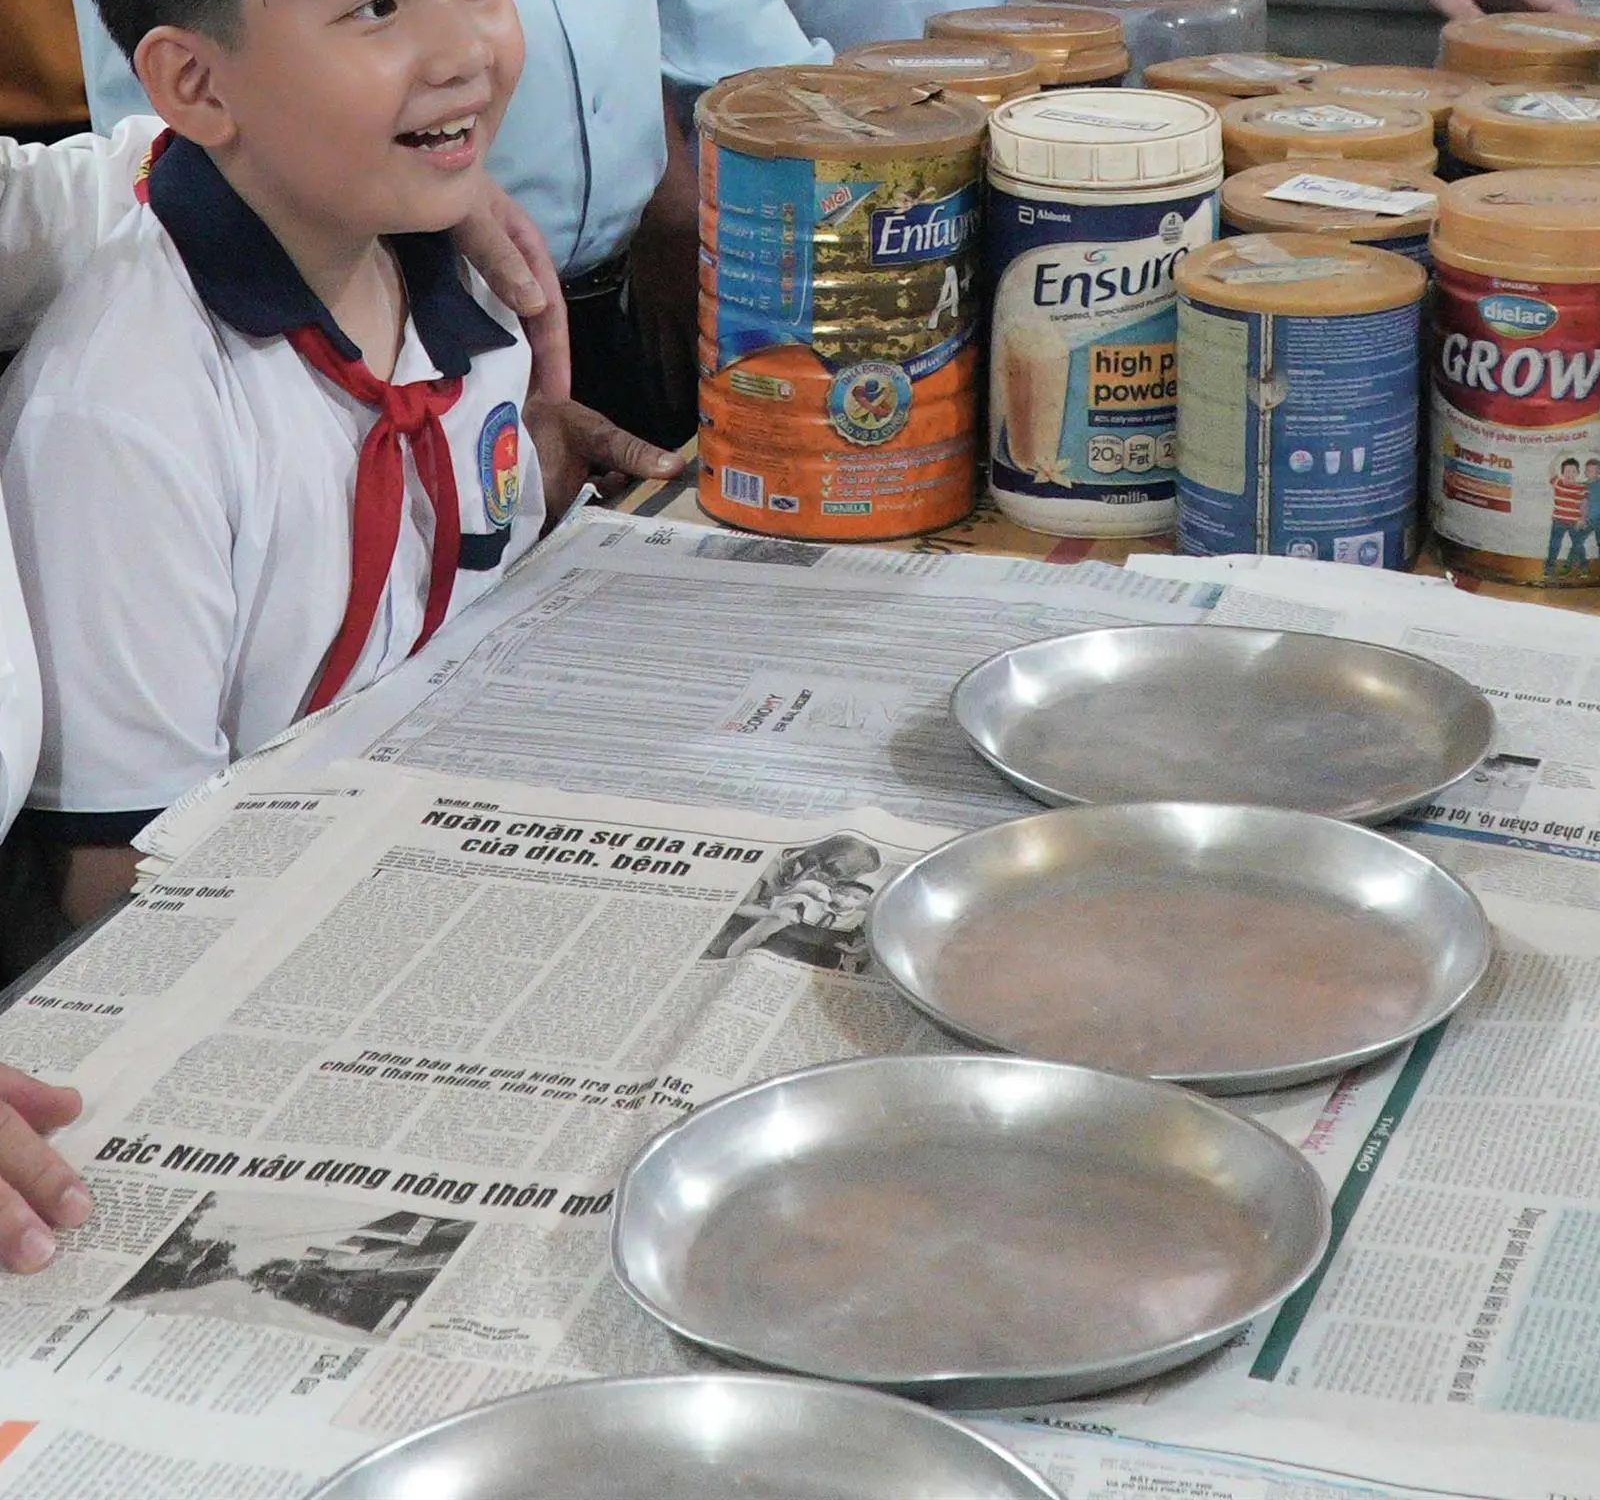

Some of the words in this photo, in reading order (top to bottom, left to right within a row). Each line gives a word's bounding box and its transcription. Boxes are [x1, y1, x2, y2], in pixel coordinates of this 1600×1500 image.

[1036, 209, 1073, 224] Abbott
[1483, 300, 1548, 326] dielac
[1096, 351, 1152, 378] high
[1094, 377, 1177, 407] powde
[1090, 445, 1123, 467] 20g
[1129, 452, 1151, 468] Fat
[824, 502, 868, 514] VANILLA
[1100, 491, 1150, 506] vanilla
[421, 810, 501, 833] Ngăn
[506, 820, 593, 845] chặn
[589, 830, 632, 851] sự
[636, 834, 685, 855] gia
[692, 840, 765, 865] tăng
[460, 835, 518, 859] của
[610, 852, 691, 878] bệnh
[150, 884, 196, 898] Trung
[195, 885, 235, 899] Quốc
[95, 1132, 163, 1165] Bắc
[161, 1142, 237, 1177] Ninh
[237, 1152, 306, 1183] xây
[304, 1159, 391, 1193] dựng
[392, 1170, 478, 1206] nông
[479, 1181, 559, 1210] thôn
[558, 1187, 614, 1218] mớ
